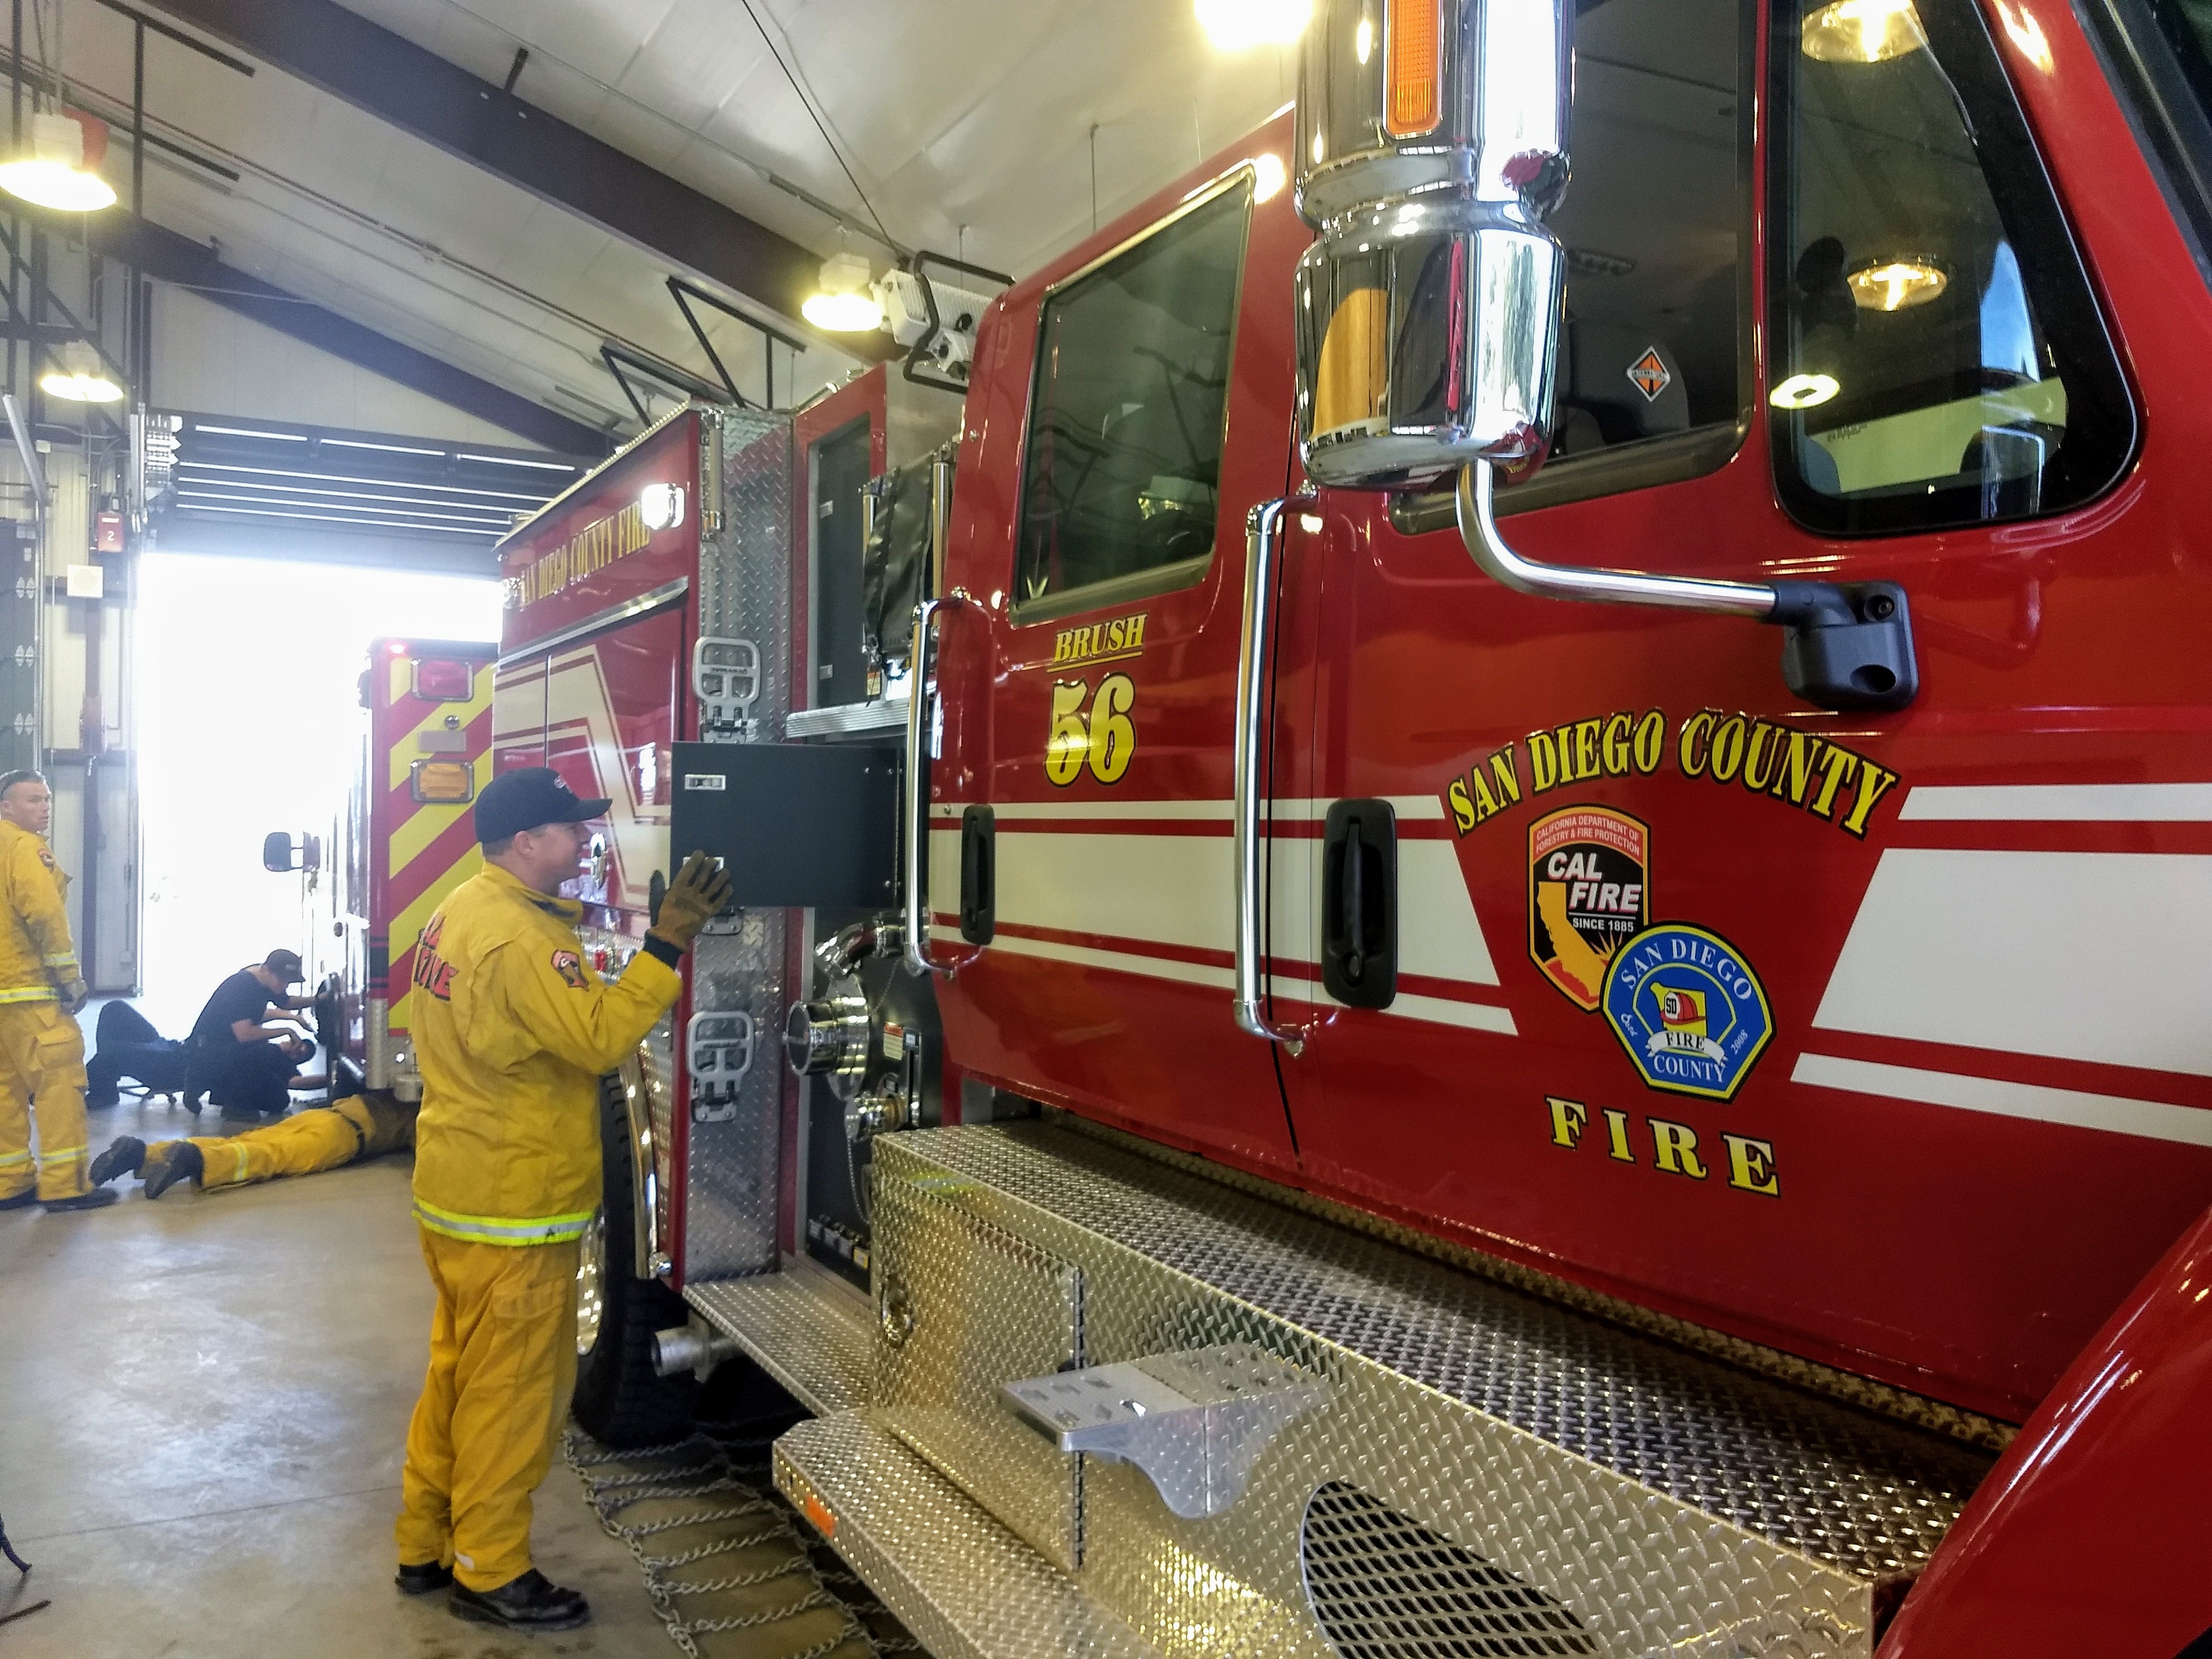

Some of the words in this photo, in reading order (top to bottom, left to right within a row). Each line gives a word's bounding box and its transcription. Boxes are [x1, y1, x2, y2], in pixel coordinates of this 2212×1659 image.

[107, 530, 115, 541] 2
[538, 544, 568, 600] DIEGO
[569, 515, 614, 584] COUNTY
[1052, 612, 1148, 663] BRUSH
[1045, 672, 1136, 788] 56
[1447, 743, 1521, 838] SAN
[1525, 708, 1667, 797] DIEGO
[1677, 709, 1901, 839] COUNTY
[1536, 830, 1568, 854] FORESTRY
[1570, 828, 1576, 838] &
[1577, 827, 1593, 838] FIRE
[1594, 828, 1640, 856] PROTECTION
[1537, 816, 1577, 840] CALIFORNIA
[1578, 815, 1627, 836] DEPARTMENT
[1628, 829, 1639, 842] OF
[1547, 851, 1602, 882] CAL
[1568, 881, 1642, 913] FIRE
[1572, 917, 1605, 930] SINCE
[1608, 919, 1634, 933] 1885
[1621, 942, 1663, 990] SAN
[1671, 938, 1752, 1000] DIEGO
[1666, 997, 1677, 1014] SD
[1666, 1032, 1705, 1051] FIRE
[1730, 1029, 1749, 1055] 2008
[1653, 1054, 1726, 1083] COUNTY
[1544, 1093, 1781, 1198] FIRE
